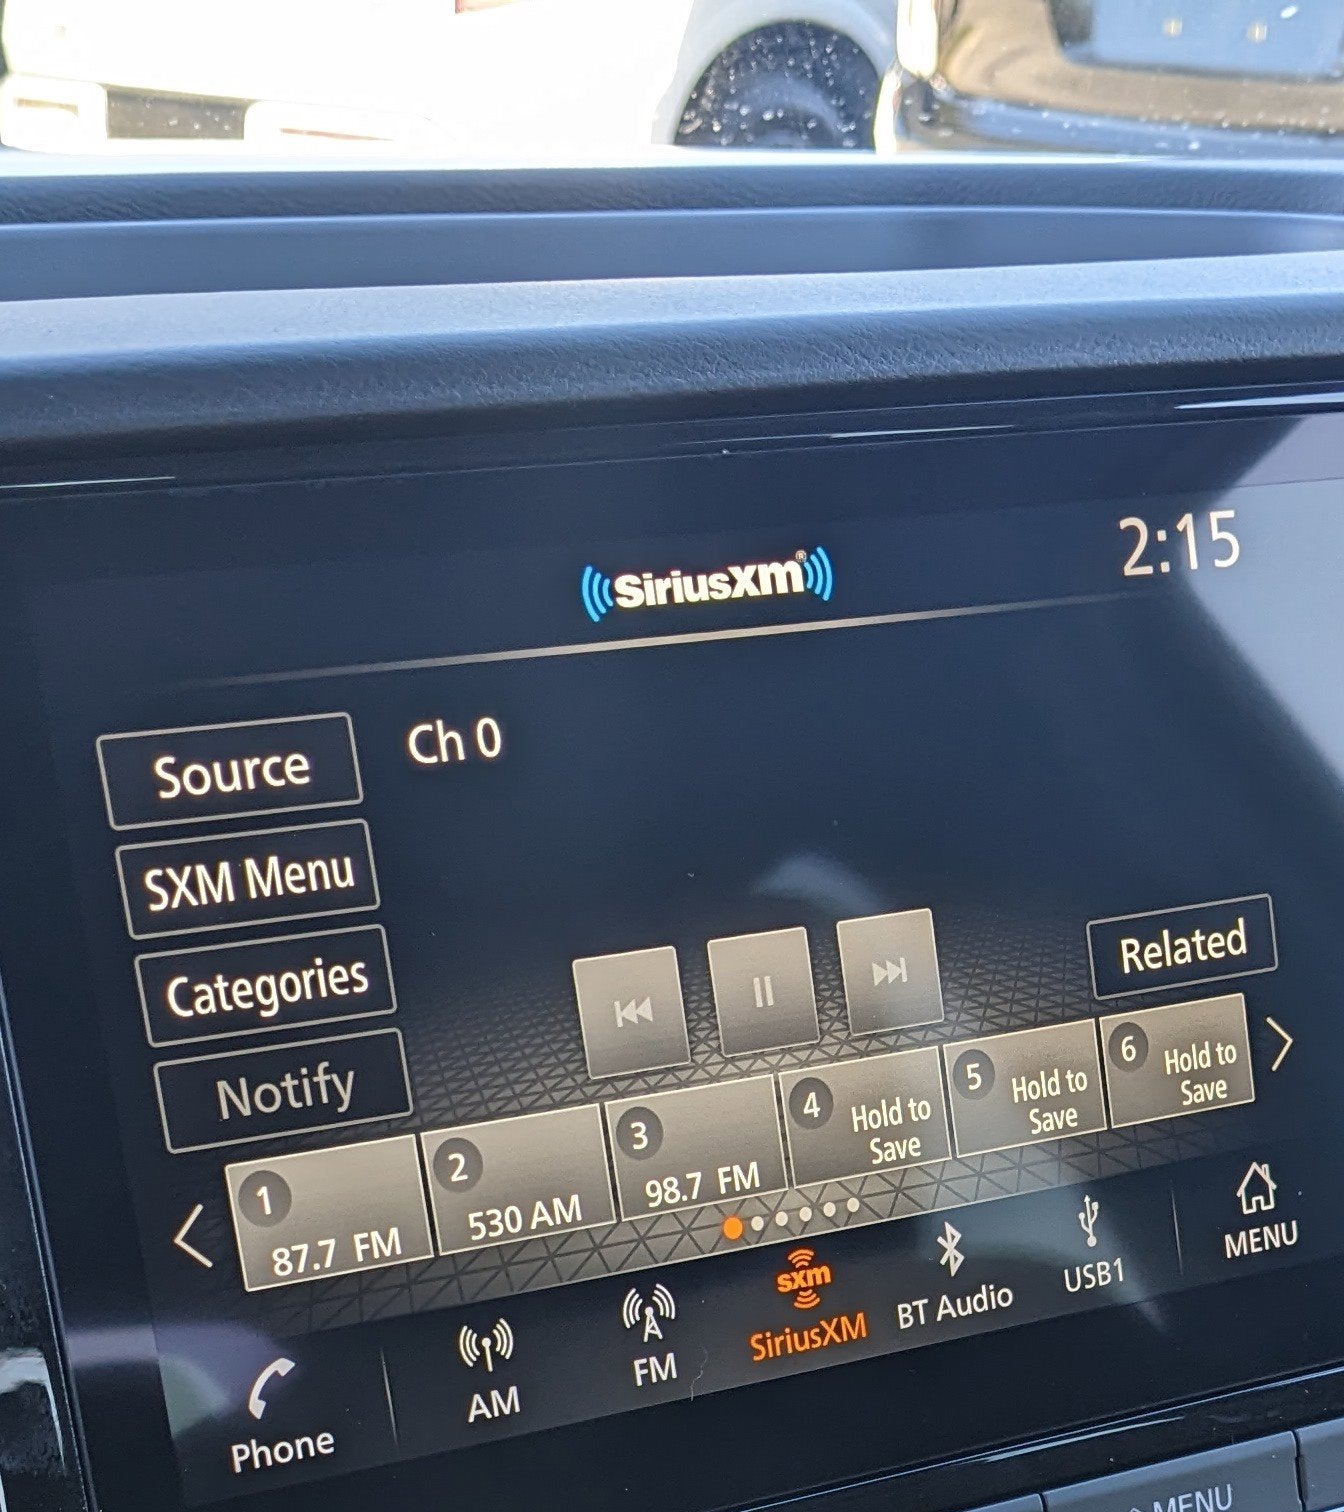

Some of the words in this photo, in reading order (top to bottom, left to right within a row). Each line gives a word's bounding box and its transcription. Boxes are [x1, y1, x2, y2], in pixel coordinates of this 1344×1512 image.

[1117, 509, 1242, 577] 2:15
[407, 719, 465, 764] Ch
[476, 716, 503, 759] 0
[154, 746, 312, 800] Source
[144, 860, 235, 912] SXM
[244, 851, 357, 899] Menu
[1119, 917, 1248, 974] Related
[165, 958, 370, 1019] Categories
[1119, 1034, 1138, 1064] 6
[1163, 1045, 1212, 1077] Hold
[1214, 1040, 1238, 1064] to
[216, 1061, 357, 1122] Notify
[965, 1062, 983, 1092] 5
[1011, 1073, 1061, 1105] Hold
[1066, 1068, 1089, 1093] to
[1179, 1077, 1228, 1107] Save
[802, 1091, 821, 1119] 4
[850, 1103, 904, 1134] Hold
[908, 1097, 932, 1122] to
[1029, 1105, 1079, 1135] Save
[629, 1122, 649, 1151] 3
[868, 1135, 922, 1166] Save
[447, 1152, 469, 1182] 2
[644, 1171, 702, 1209] 98.7
[717, 1162, 761, 1196] FM
[254, 1184, 273, 1216] 1
[468, 1205, 522, 1241] 530
[530, 1193, 583, 1231] AM
[271, 1238, 336, 1277] 87.7
[354, 1227, 403, 1265] FM
[1223, 1219, 1300, 1260] MENU
[1062, 1256, 1126, 1294] USB1
[896, 1300, 930, 1330] BT
[935, 1281, 1014, 1322] Audio
[749, 1311, 869, 1363] SiriusXM
[633, 1352, 678, 1388] FM
[467, 1384, 521, 1425] AM
[230, 1430, 336, 1475] Phone
